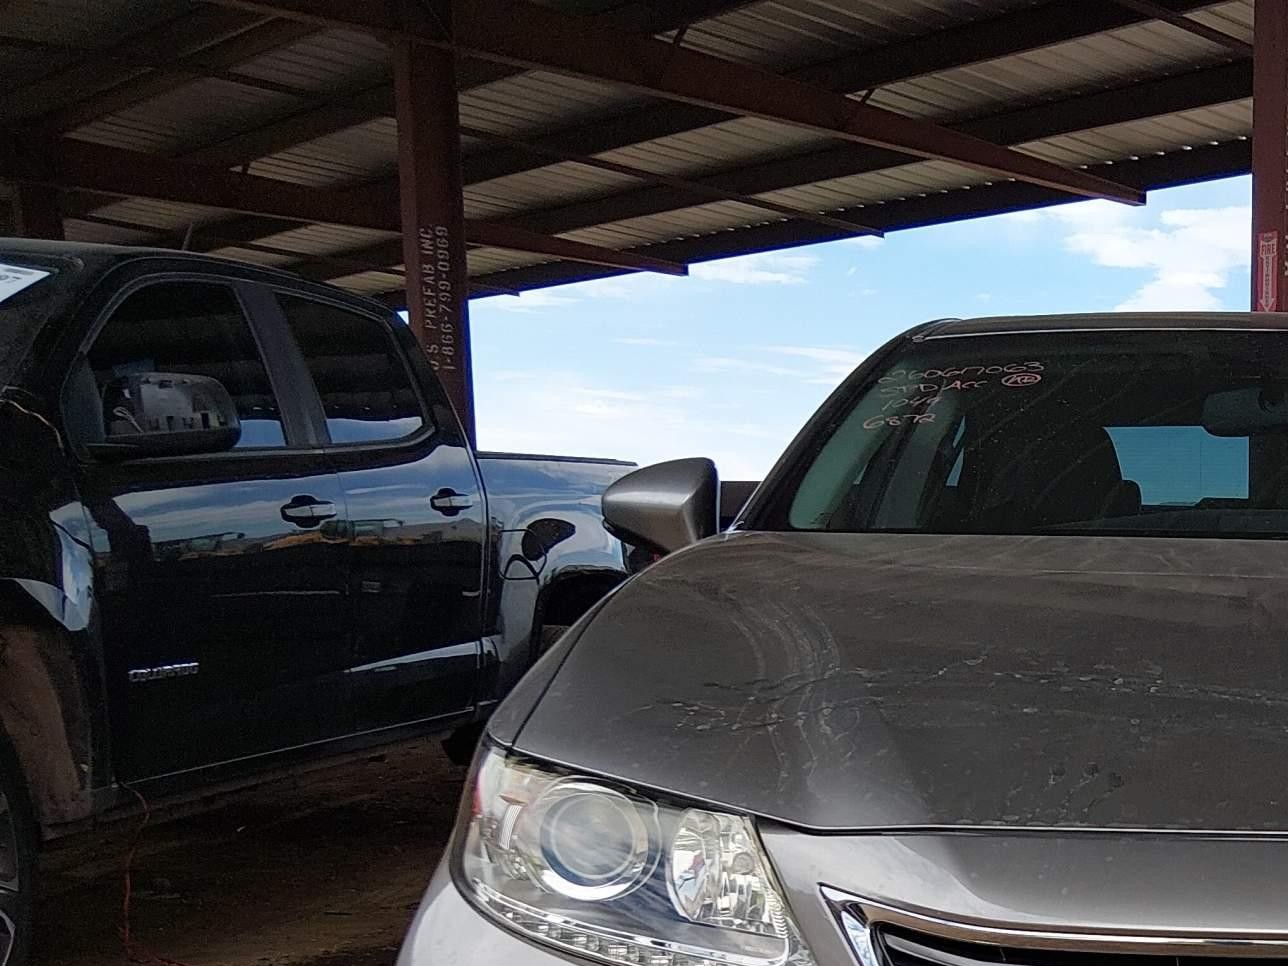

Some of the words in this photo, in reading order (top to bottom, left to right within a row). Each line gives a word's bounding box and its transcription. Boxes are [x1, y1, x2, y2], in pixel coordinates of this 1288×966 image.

[1261, 243, 1276, 256] FIRE
[422, 264, 437, 329] PREFAB
[435, 226, 455, 371] 1-866-799-0969
